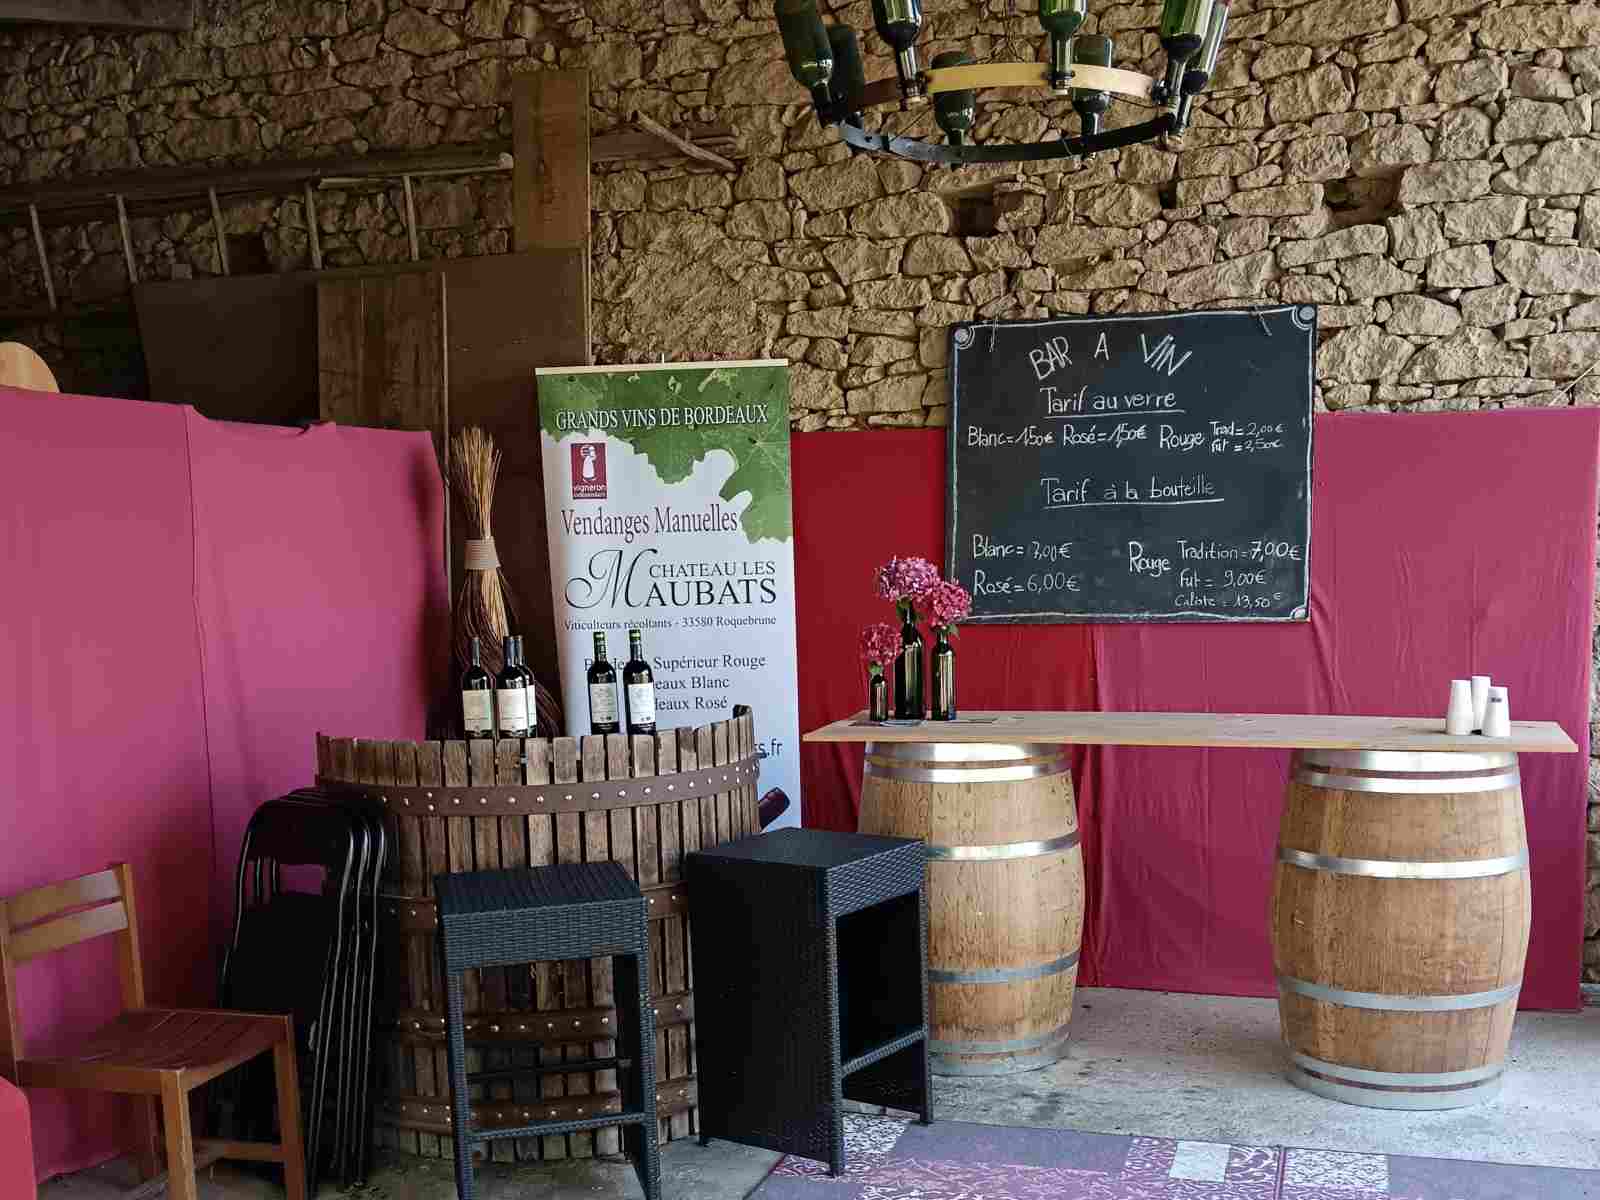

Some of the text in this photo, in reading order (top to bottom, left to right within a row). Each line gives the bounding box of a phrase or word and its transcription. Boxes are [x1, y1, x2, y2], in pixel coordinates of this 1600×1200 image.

[1029, 332, 1192, 380] BAR A VIN
[1040, 385, 1176, 414] Tarif au verre
[556, 403, 768, 431] GRANDS VINS DE BORDEAUX
[1159, 424, 1205, 451] Rouge
[1040, 477, 1091, 504] Tarif
[1150, 473, 1216, 498] bouteille
[561, 503, 738, 543] Vendanges Manuelles
[649, 560, 775, 578] CHATEAU LES
[1128, 541, 1171, 577] Rouge
[564, 618, 622, 632] Viticulteurs
[624, 617, 673, 630] récoltants
[681, 616, 713, 628] 33580
[716, 614, 777, 629] Roquebrune
[653, 653, 766, 673] Supérieur Rouge
[691, 675, 730, 690] Blanc
[694, 696, 729, 711] Rosé
